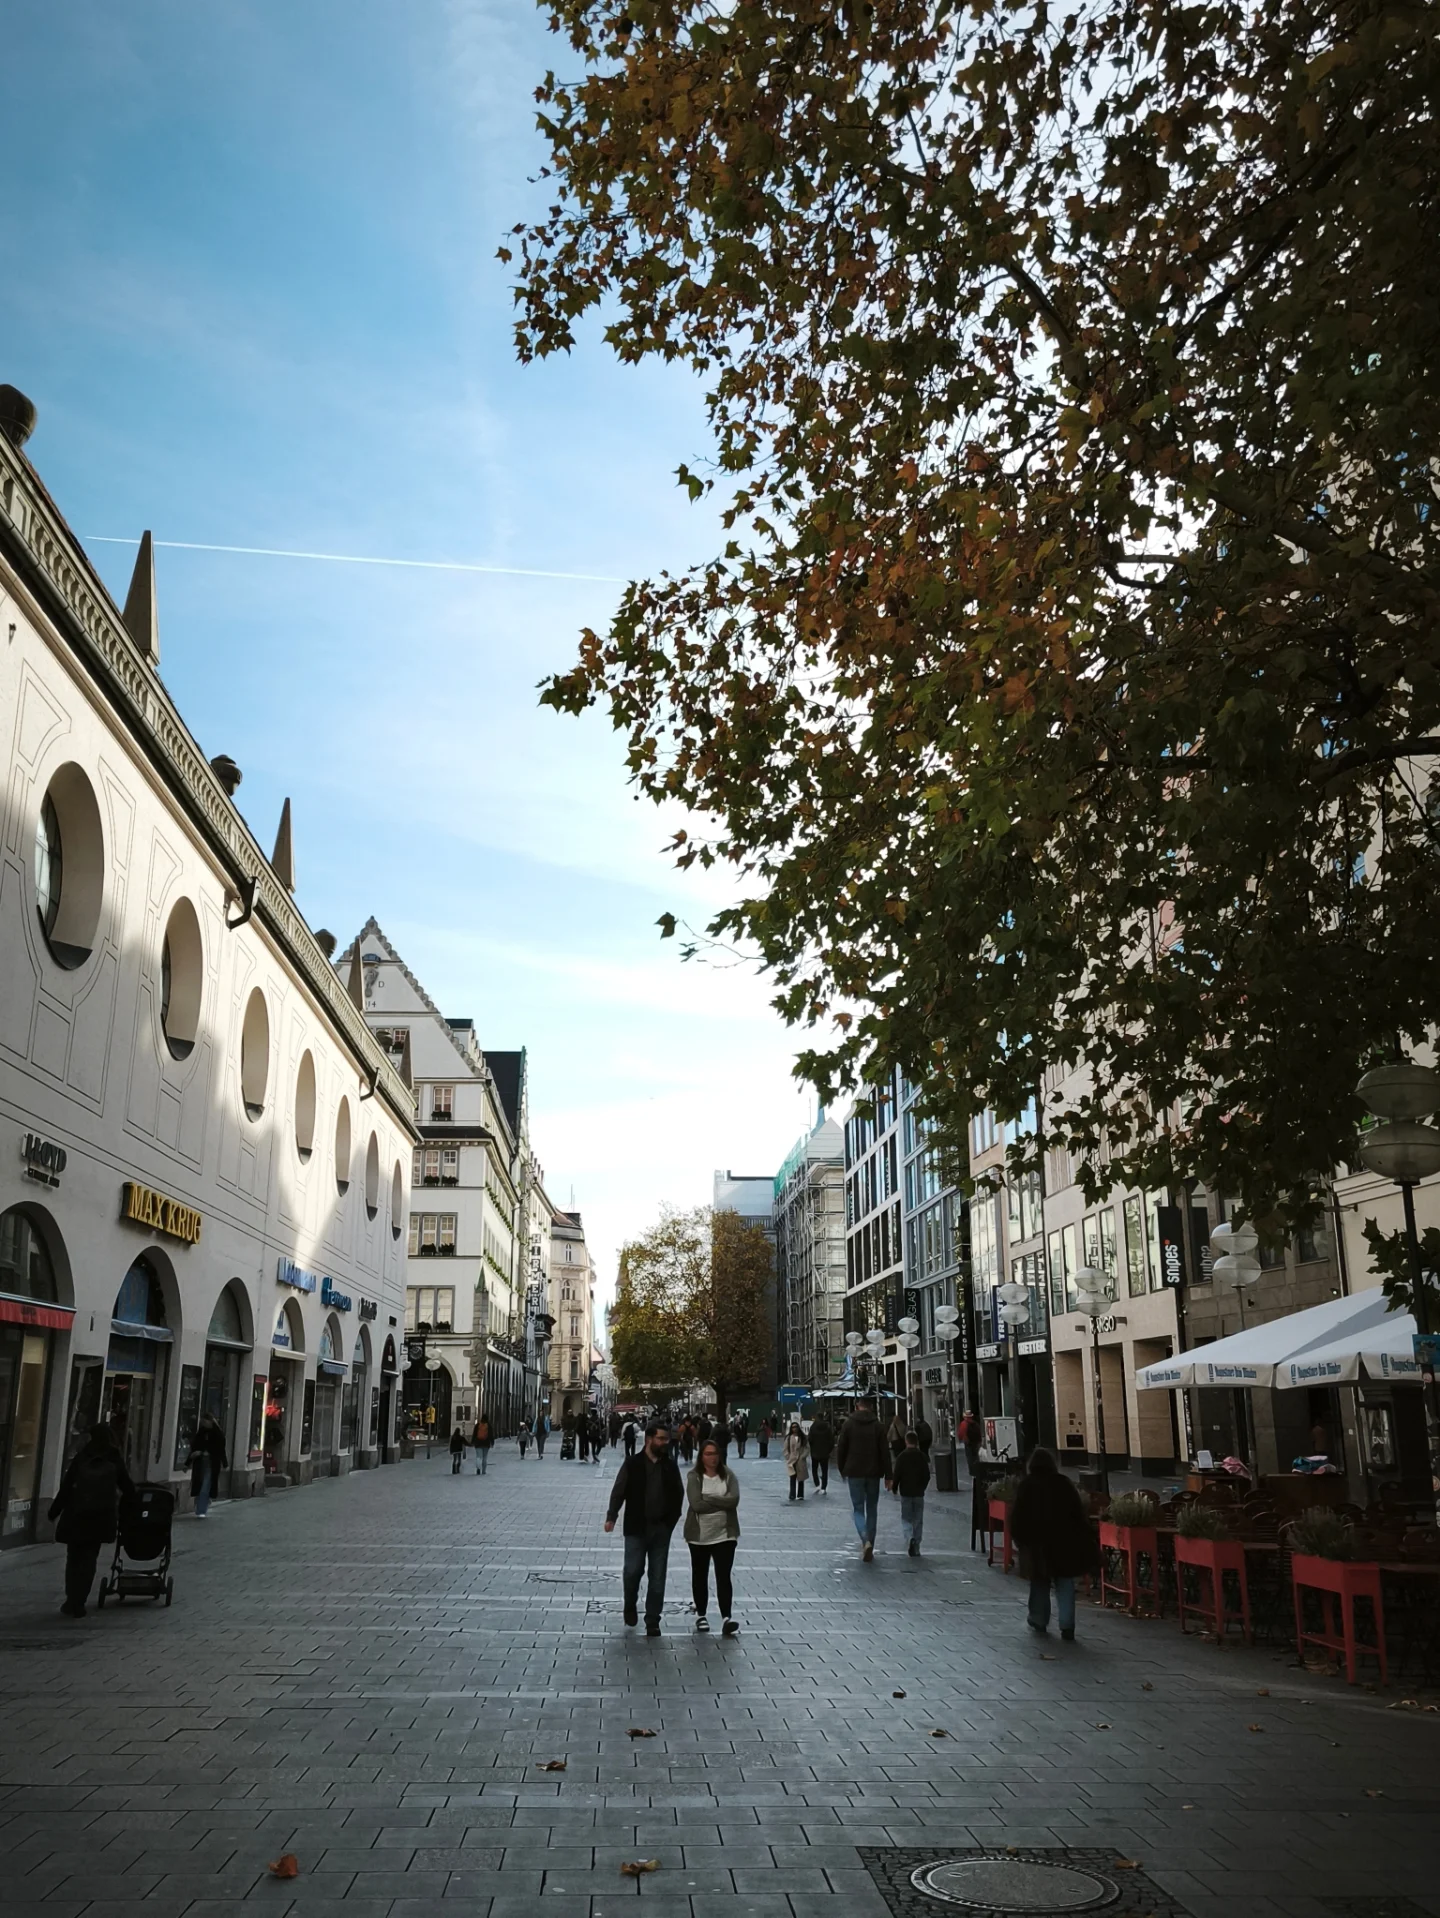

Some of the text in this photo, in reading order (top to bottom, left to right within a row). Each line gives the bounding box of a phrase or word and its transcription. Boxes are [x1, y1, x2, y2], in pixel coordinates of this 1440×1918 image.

[125, 1182, 202, 1245] MAX KRUG
[531, 1234, 541, 1307] HIRMER
[1165, 1244, 1181, 1283] snipes
